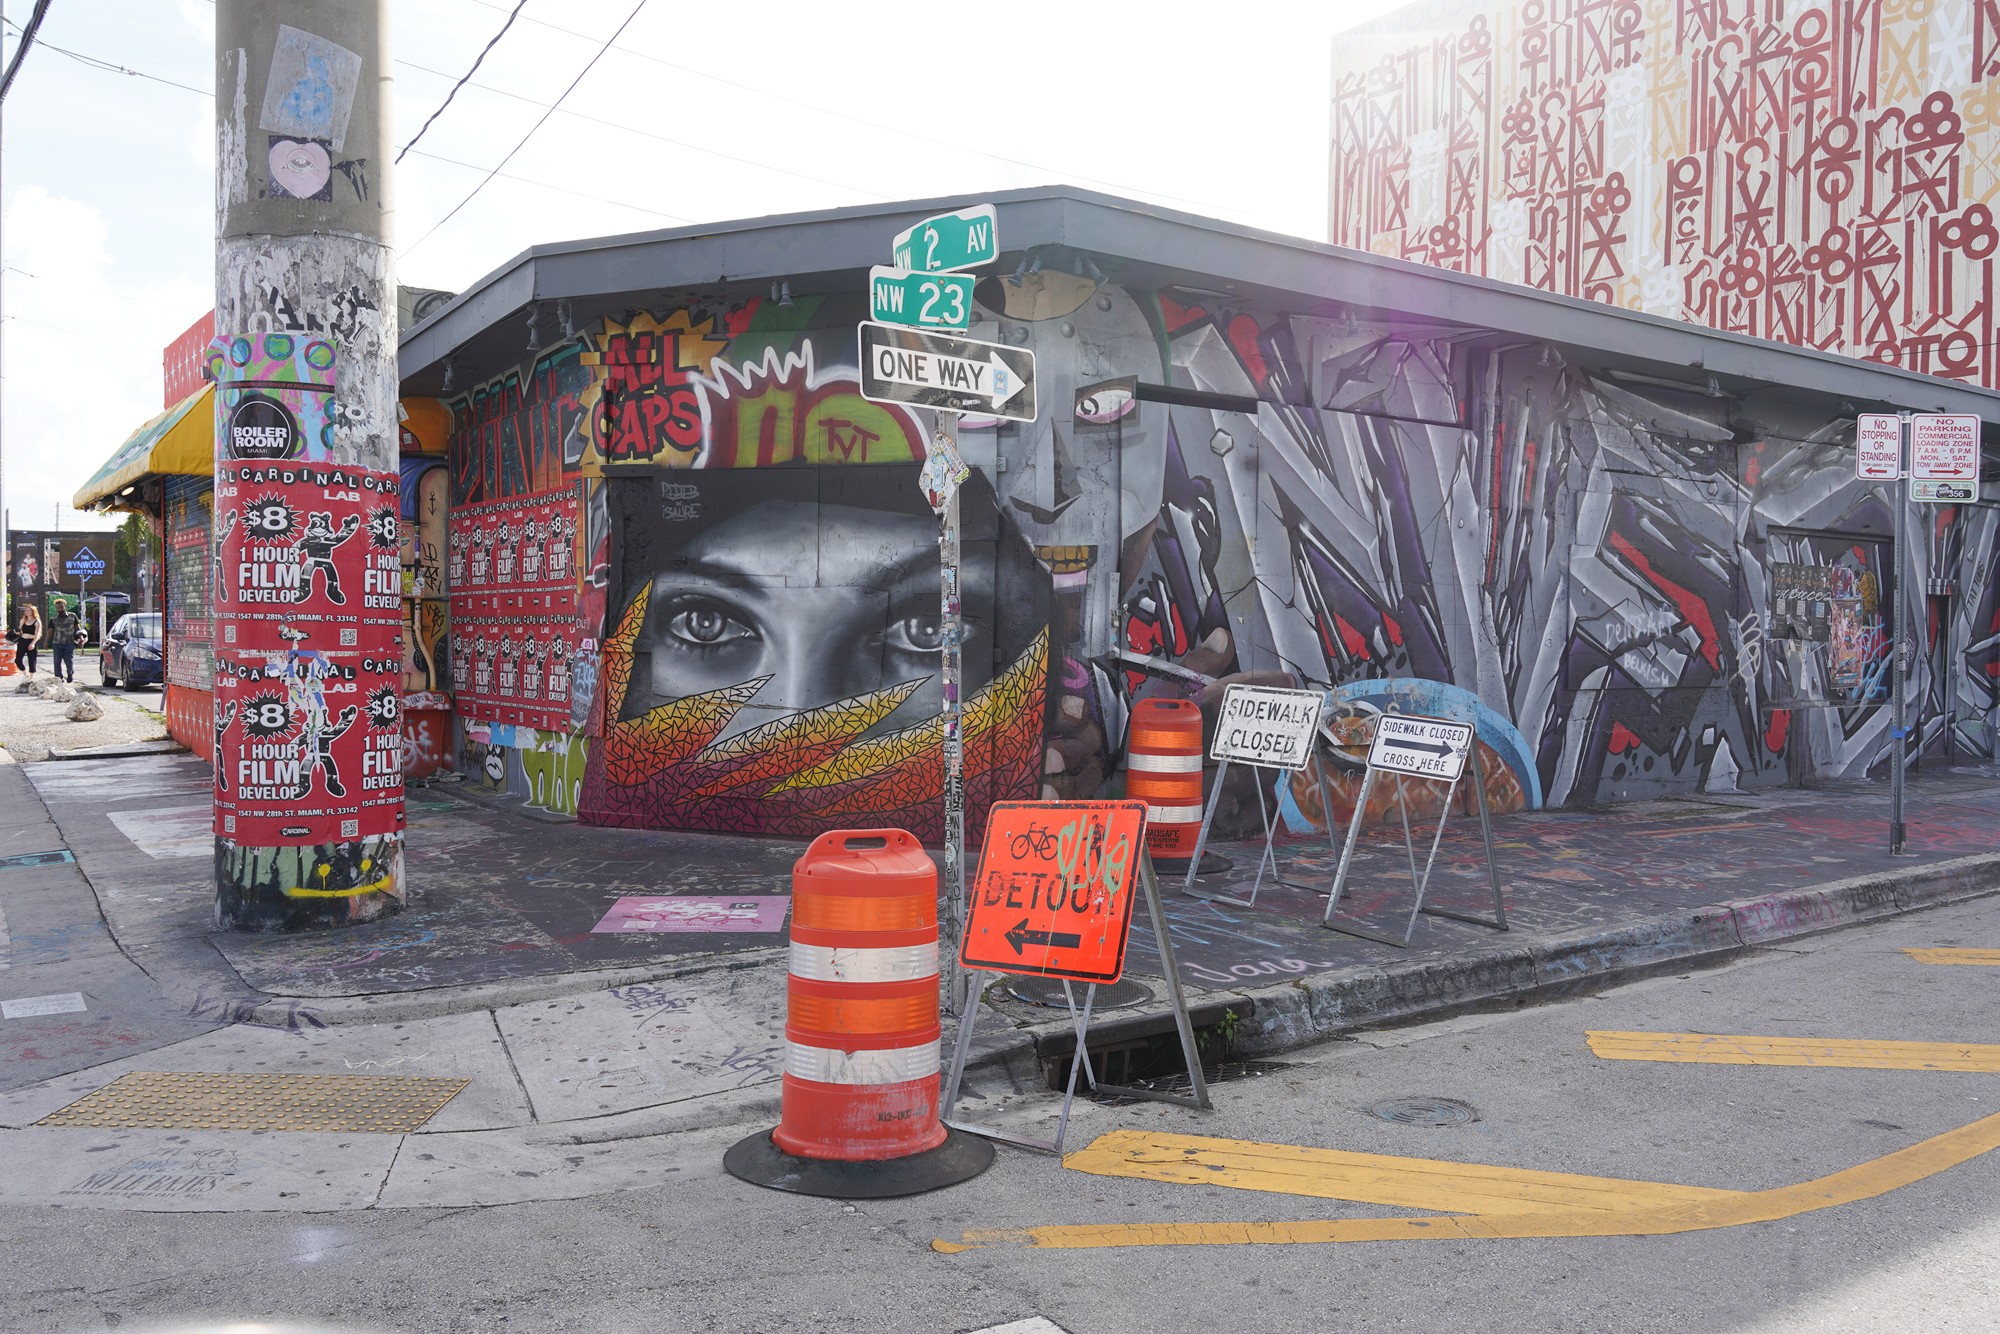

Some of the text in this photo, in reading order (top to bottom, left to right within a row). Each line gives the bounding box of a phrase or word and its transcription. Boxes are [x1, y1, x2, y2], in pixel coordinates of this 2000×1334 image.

[896, 222, 987, 270] NW 2 AV
[877, 282, 964, 324] NW 23
[880, 350, 984, 390] ONE WAY
[594, 391, 701, 453] CAPS
[1874, 420, 1887, 430] NO
[233, 427, 287, 438] BOILER
[1862, 430, 1897, 440] STOPPING
[235, 437, 284, 447] ROOM
[1874, 441, 1884, 450] OR
[1860, 452, 1896, 461] STANDING
[241, 466, 358, 488] CARDINAL
[218, 487, 237, 497] LAB
[324, 490, 360, 501] LAB
[249, 507, 287, 530] $8
[551, 517, 561, 532] $8
[372, 517, 396, 540] $8
[525, 522, 535, 536] $8
[240, 546, 299, 563] 1 HOUR
[365, 555, 371, 569] 1
[550, 554, 565, 570] FILM
[65, 561, 105, 569] WYNWOOD
[239, 563, 300, 588] FILM
[239, 589, 300, 603] DEVELOP
[297, 614, 323, 622] MIAMI,
[501, 639, 510, 653] $8
[525, 639, 535, 654] $8
[553, 639, 562, 655] $8
[217, 677, 237, 688] LAB
[372, 696, 396, 718] $8
[1227, 697, 1315, 724] SIDEWALK
[246, 704, 285, 727] $8
[1383, 720, 1465, 741] SIDEWALK CLOSED
[363, 736, 370, 750] 1
[1230, 729, 1297, 754] CLOSED
[239, 744, 298, 760] 1 HOUR
[1383, 752, 1447, 772] CROSS HERE
[239, 760, 300, 785] FILM
[239, 786, 300, 800] DEVELOP
[297, 809, 324, 817] MIAMI,
[337, 807, 358, 815] 33142
